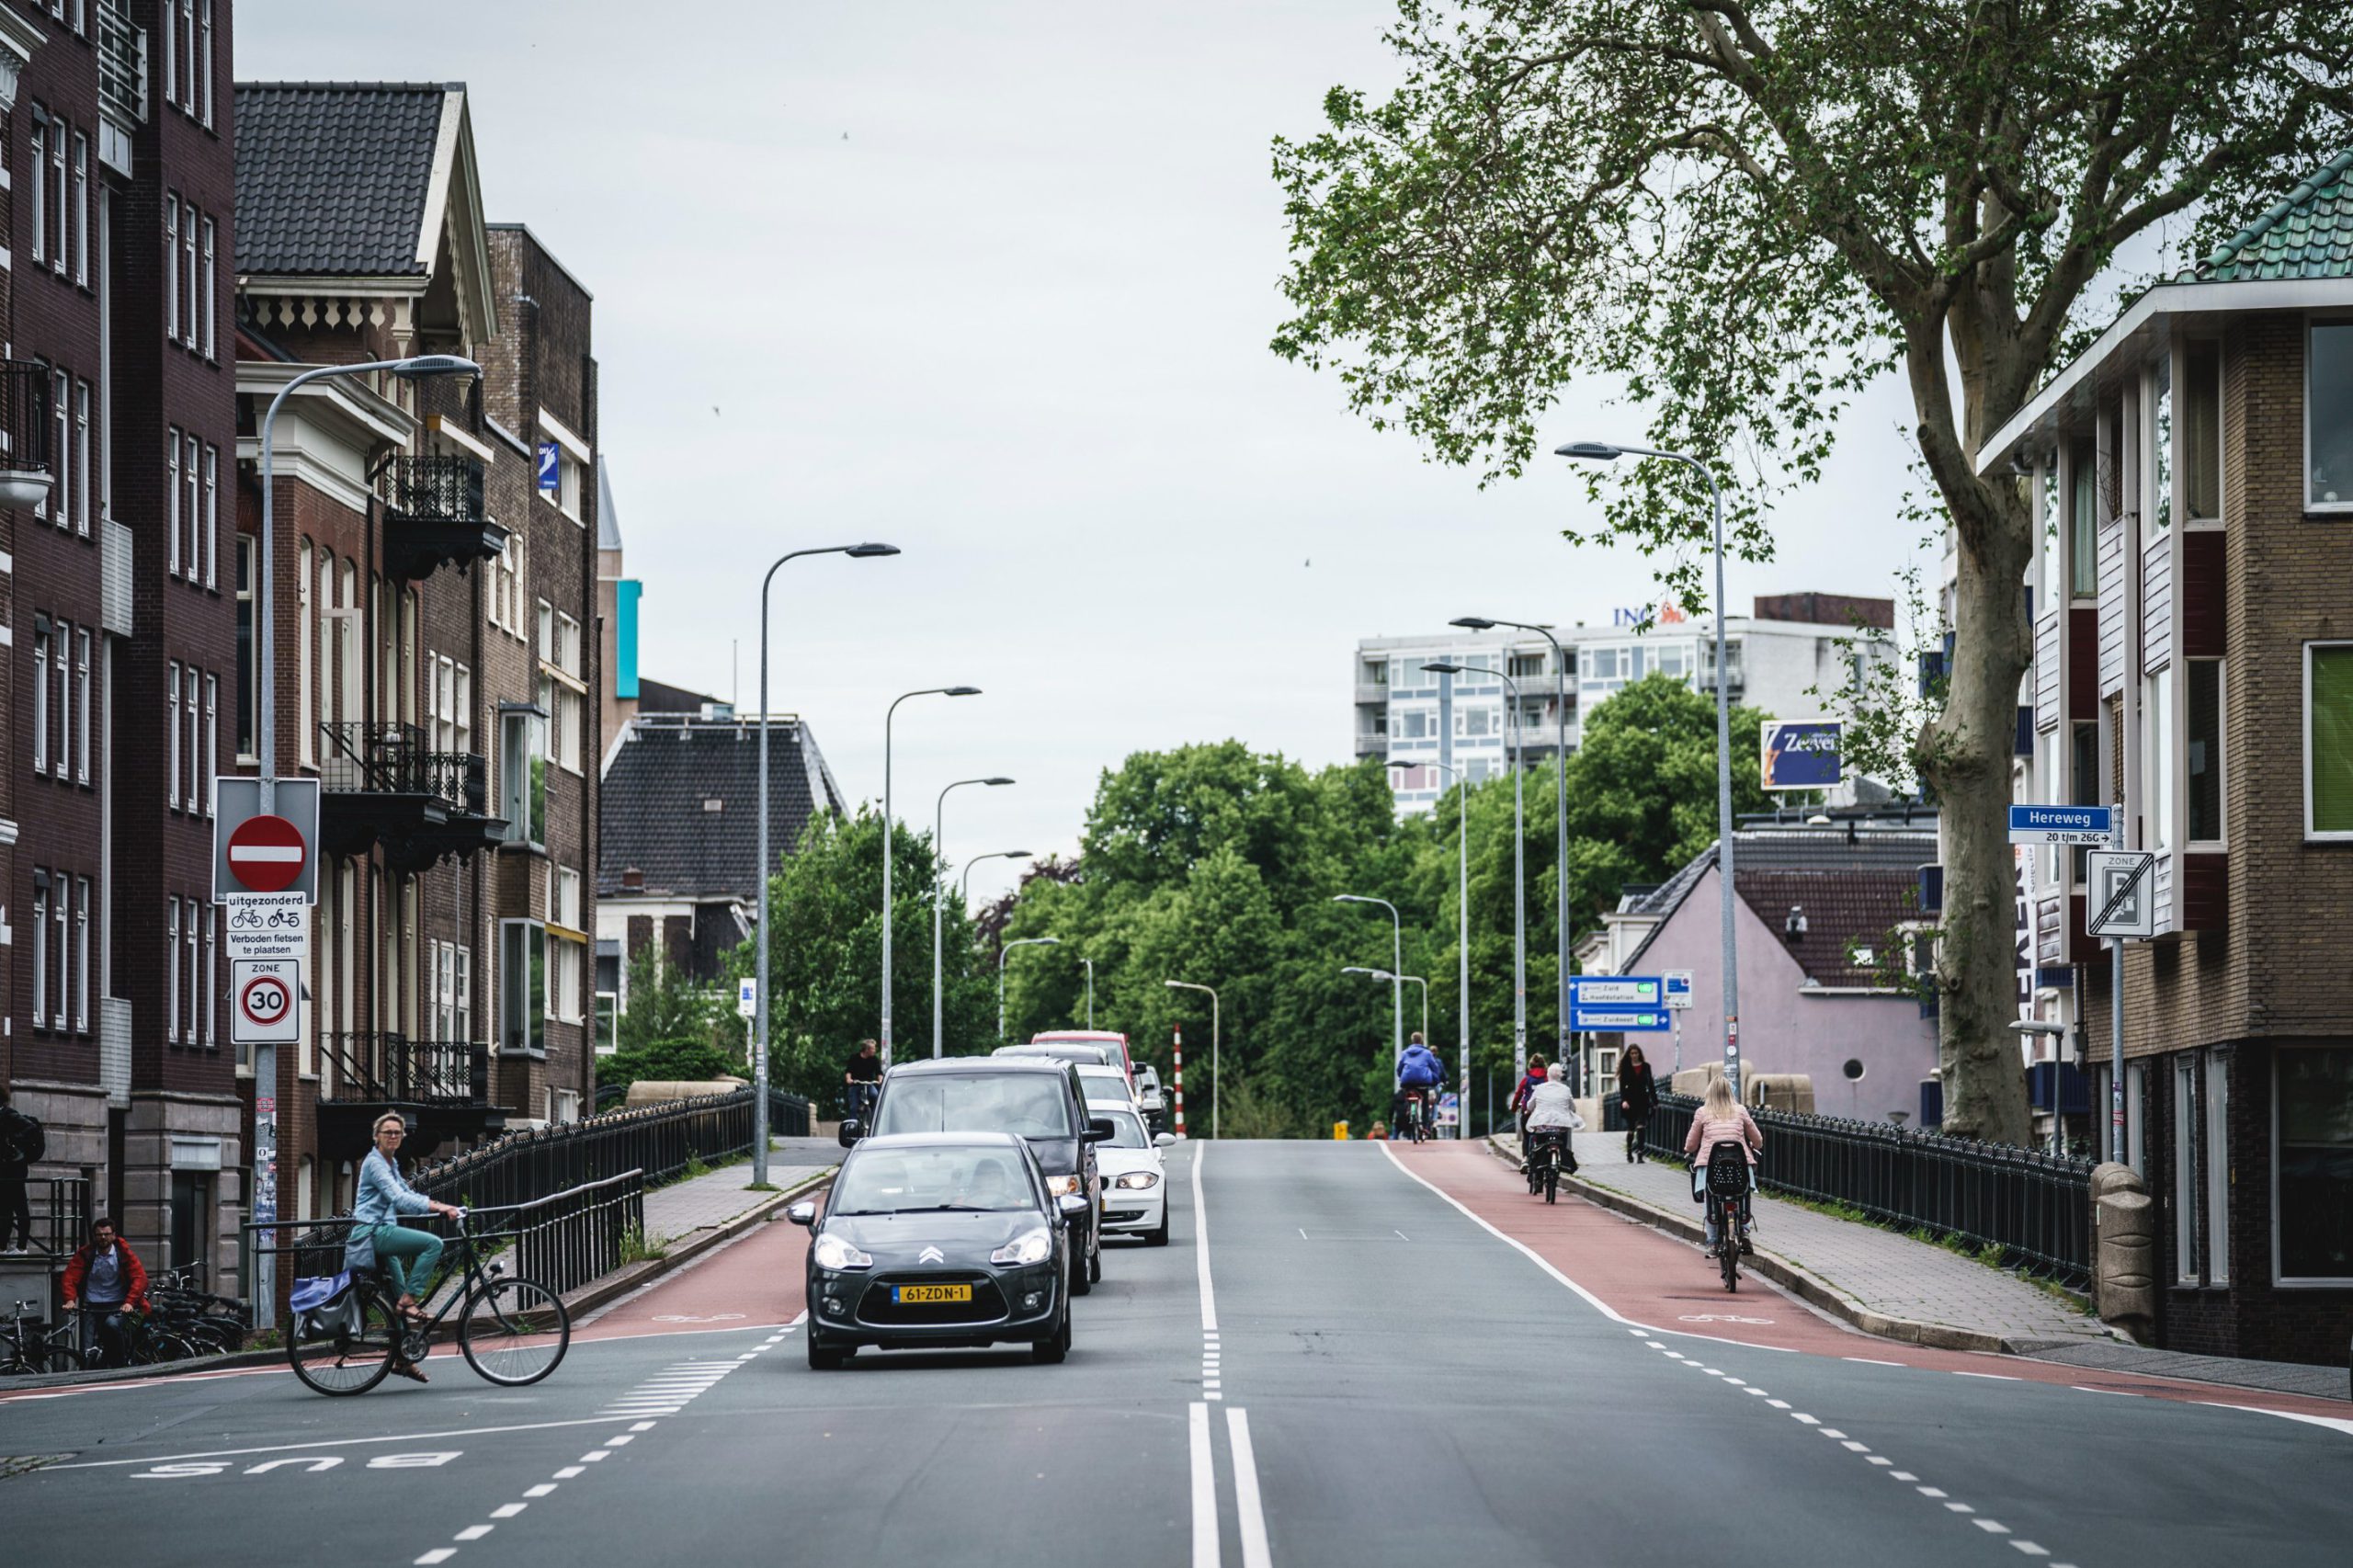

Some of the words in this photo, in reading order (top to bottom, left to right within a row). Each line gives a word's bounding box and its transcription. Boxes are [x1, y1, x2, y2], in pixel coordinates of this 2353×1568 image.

[2029, 811, 2091, 827] Hereweg
[2046, 832, 2059, 842] 20
[2062, 832, 2078, 844] t/m
[2081, 833, 2100, 843] 26G
[2109, 857, 2135, 866] ZONE
[229, 895, 303, 908] uitgezonderd
[230, 934, 272, 943] Verboden
[274, 934, 303, 943] fietsen
[243, 946, 252, 954] te
[254, 945, 291, 956] plaatsen
[251, 963, 280, 972] ZONE
[251, 991, 283, 1010] 30
[906, 1287, 964, 1301] 61-ZDN-1
[130, 1450, 464, 1479] BUS
